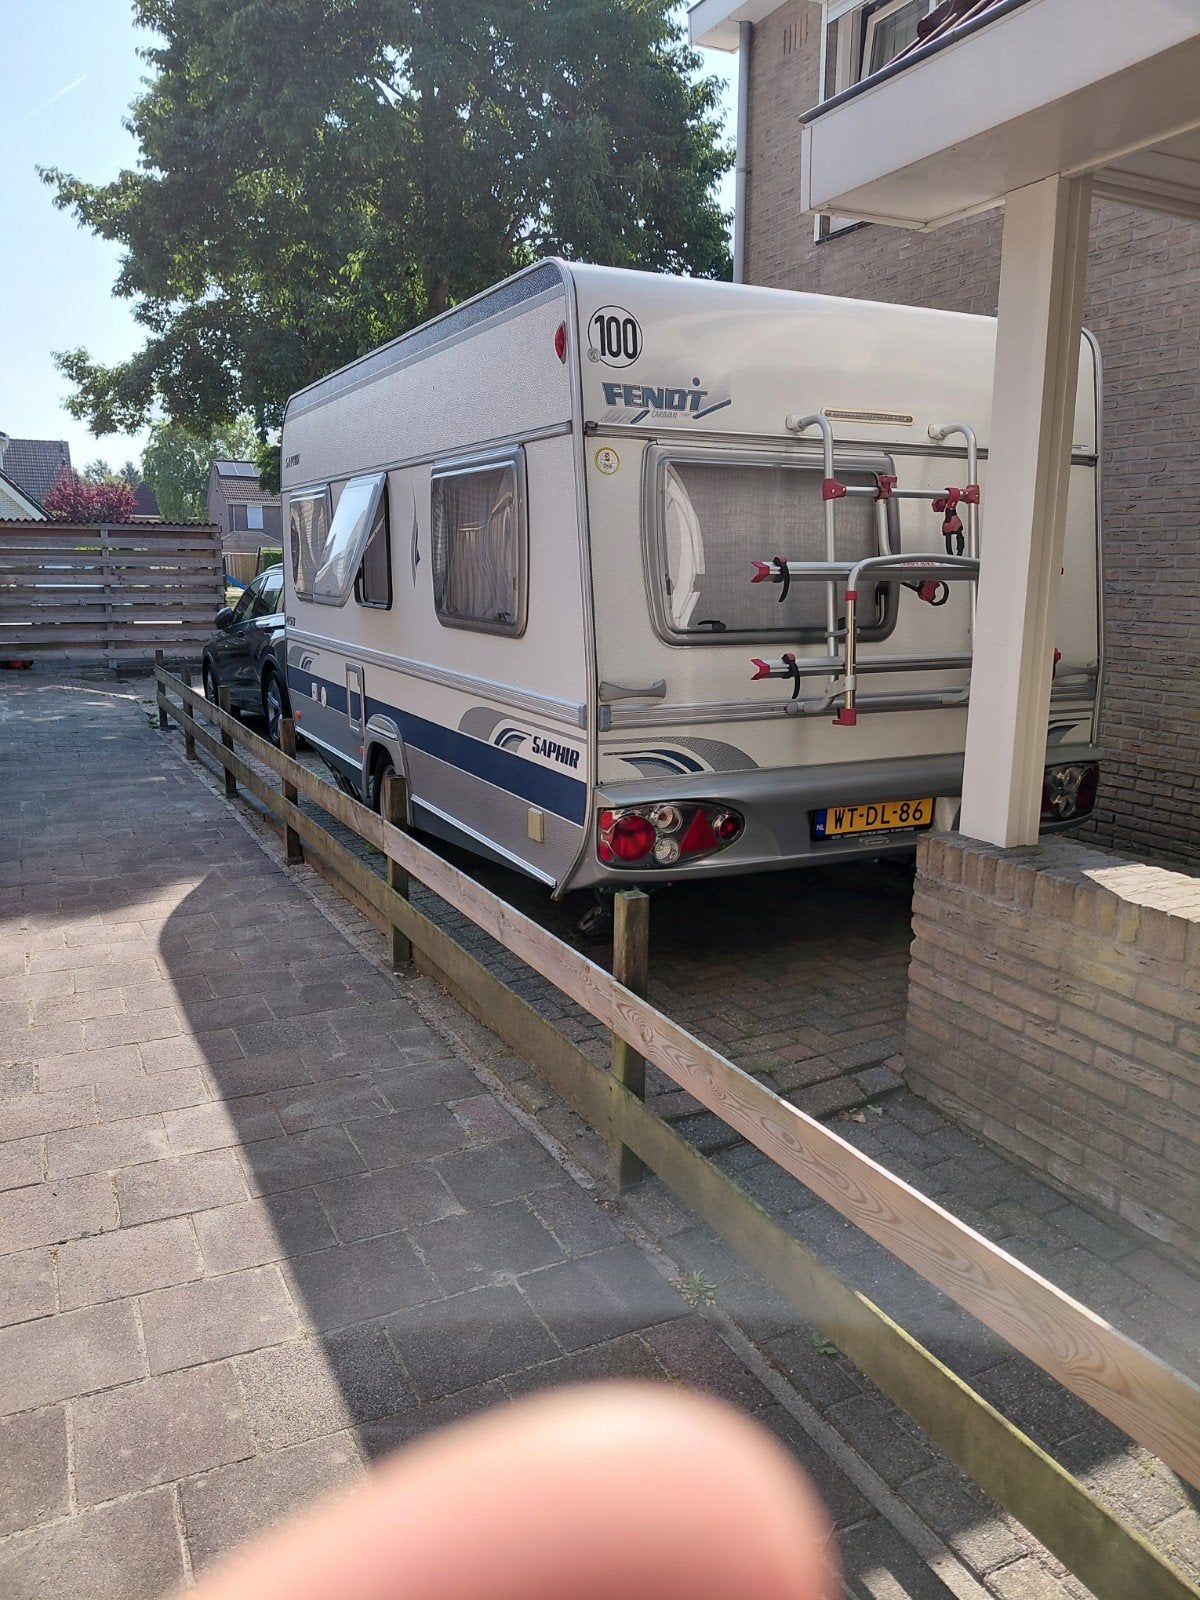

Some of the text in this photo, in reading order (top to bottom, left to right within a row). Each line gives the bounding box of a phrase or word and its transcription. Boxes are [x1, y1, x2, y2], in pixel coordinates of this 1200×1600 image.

[594, 315, 638, 360] 100
[602, 381, 709, 412] FENDT
[651, 410, 678, 419] CARAVAN
[532, 735, 580, 770] SAPHIR
[834, 801, 924, 830] WT-DL-86
